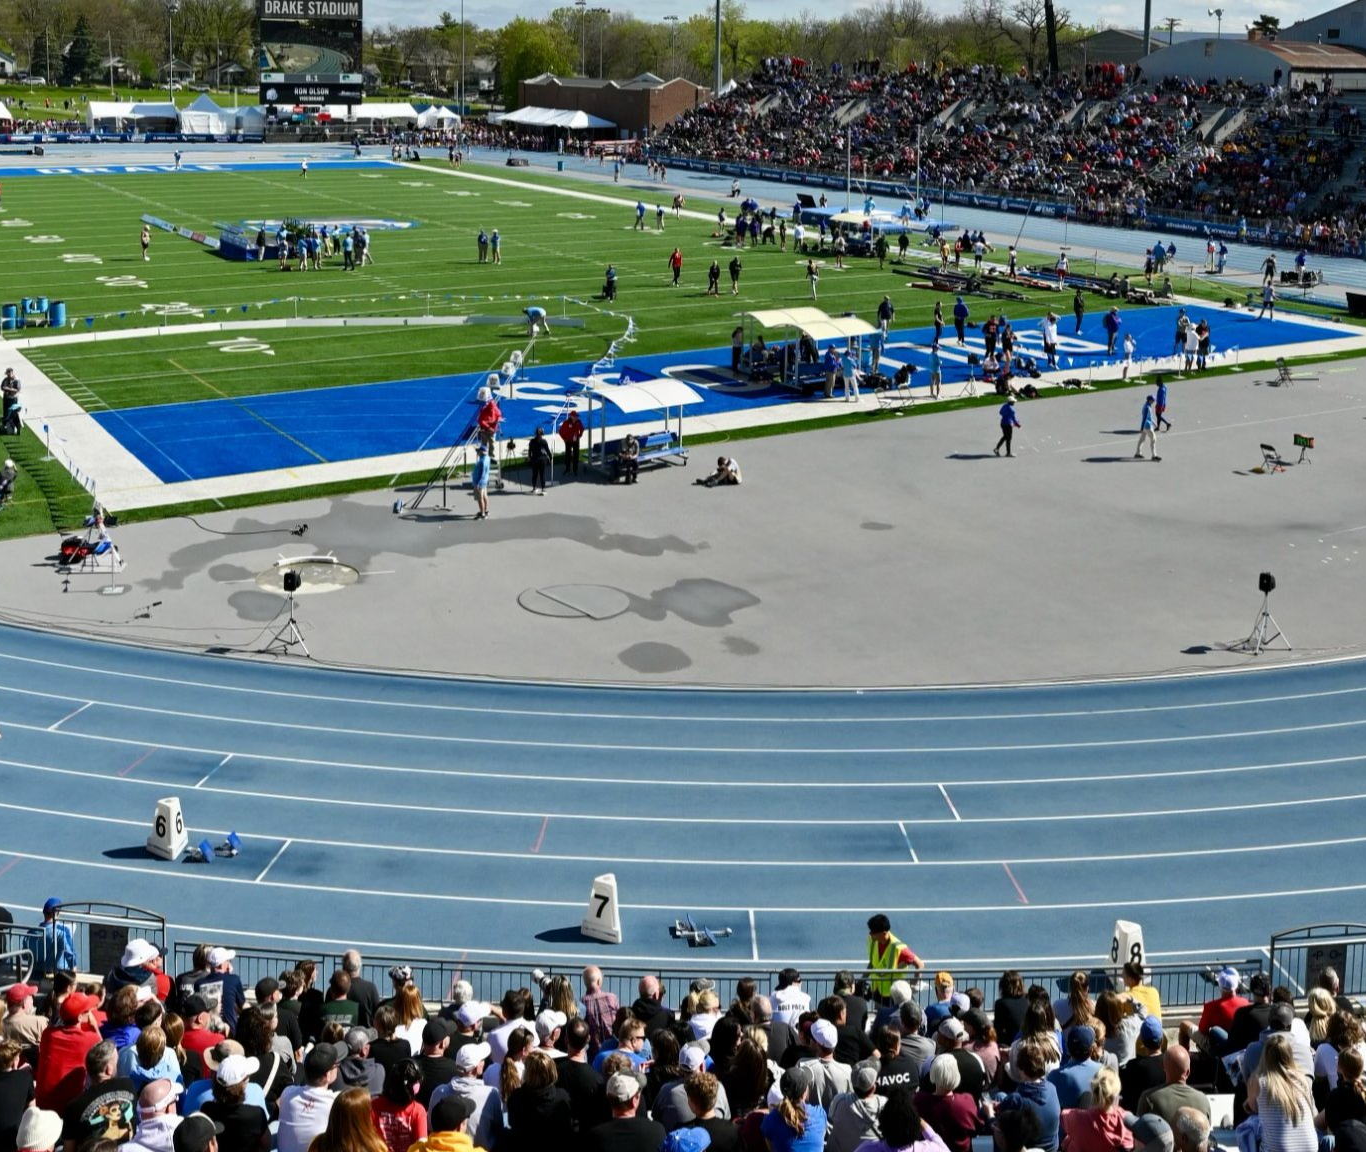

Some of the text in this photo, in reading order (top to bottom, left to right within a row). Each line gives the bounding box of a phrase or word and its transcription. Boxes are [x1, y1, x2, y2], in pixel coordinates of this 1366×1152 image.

[265, 0, 359, 16] DRAKE STADIUM
[294, 87, 308, 95] RON
[36, 165, 232, 174] DRAKE
[155, 815, 167, 838] 6
[175, 812, 182, 835] 6
[592, 893, 610, 919] 7
[1111, 936, 1120, 964] 8
[1130, 942, 1143, 965] 8
[777, 1004, 791, 1012] BOLT
[875, 1072, 911, 1087] HAVOC
